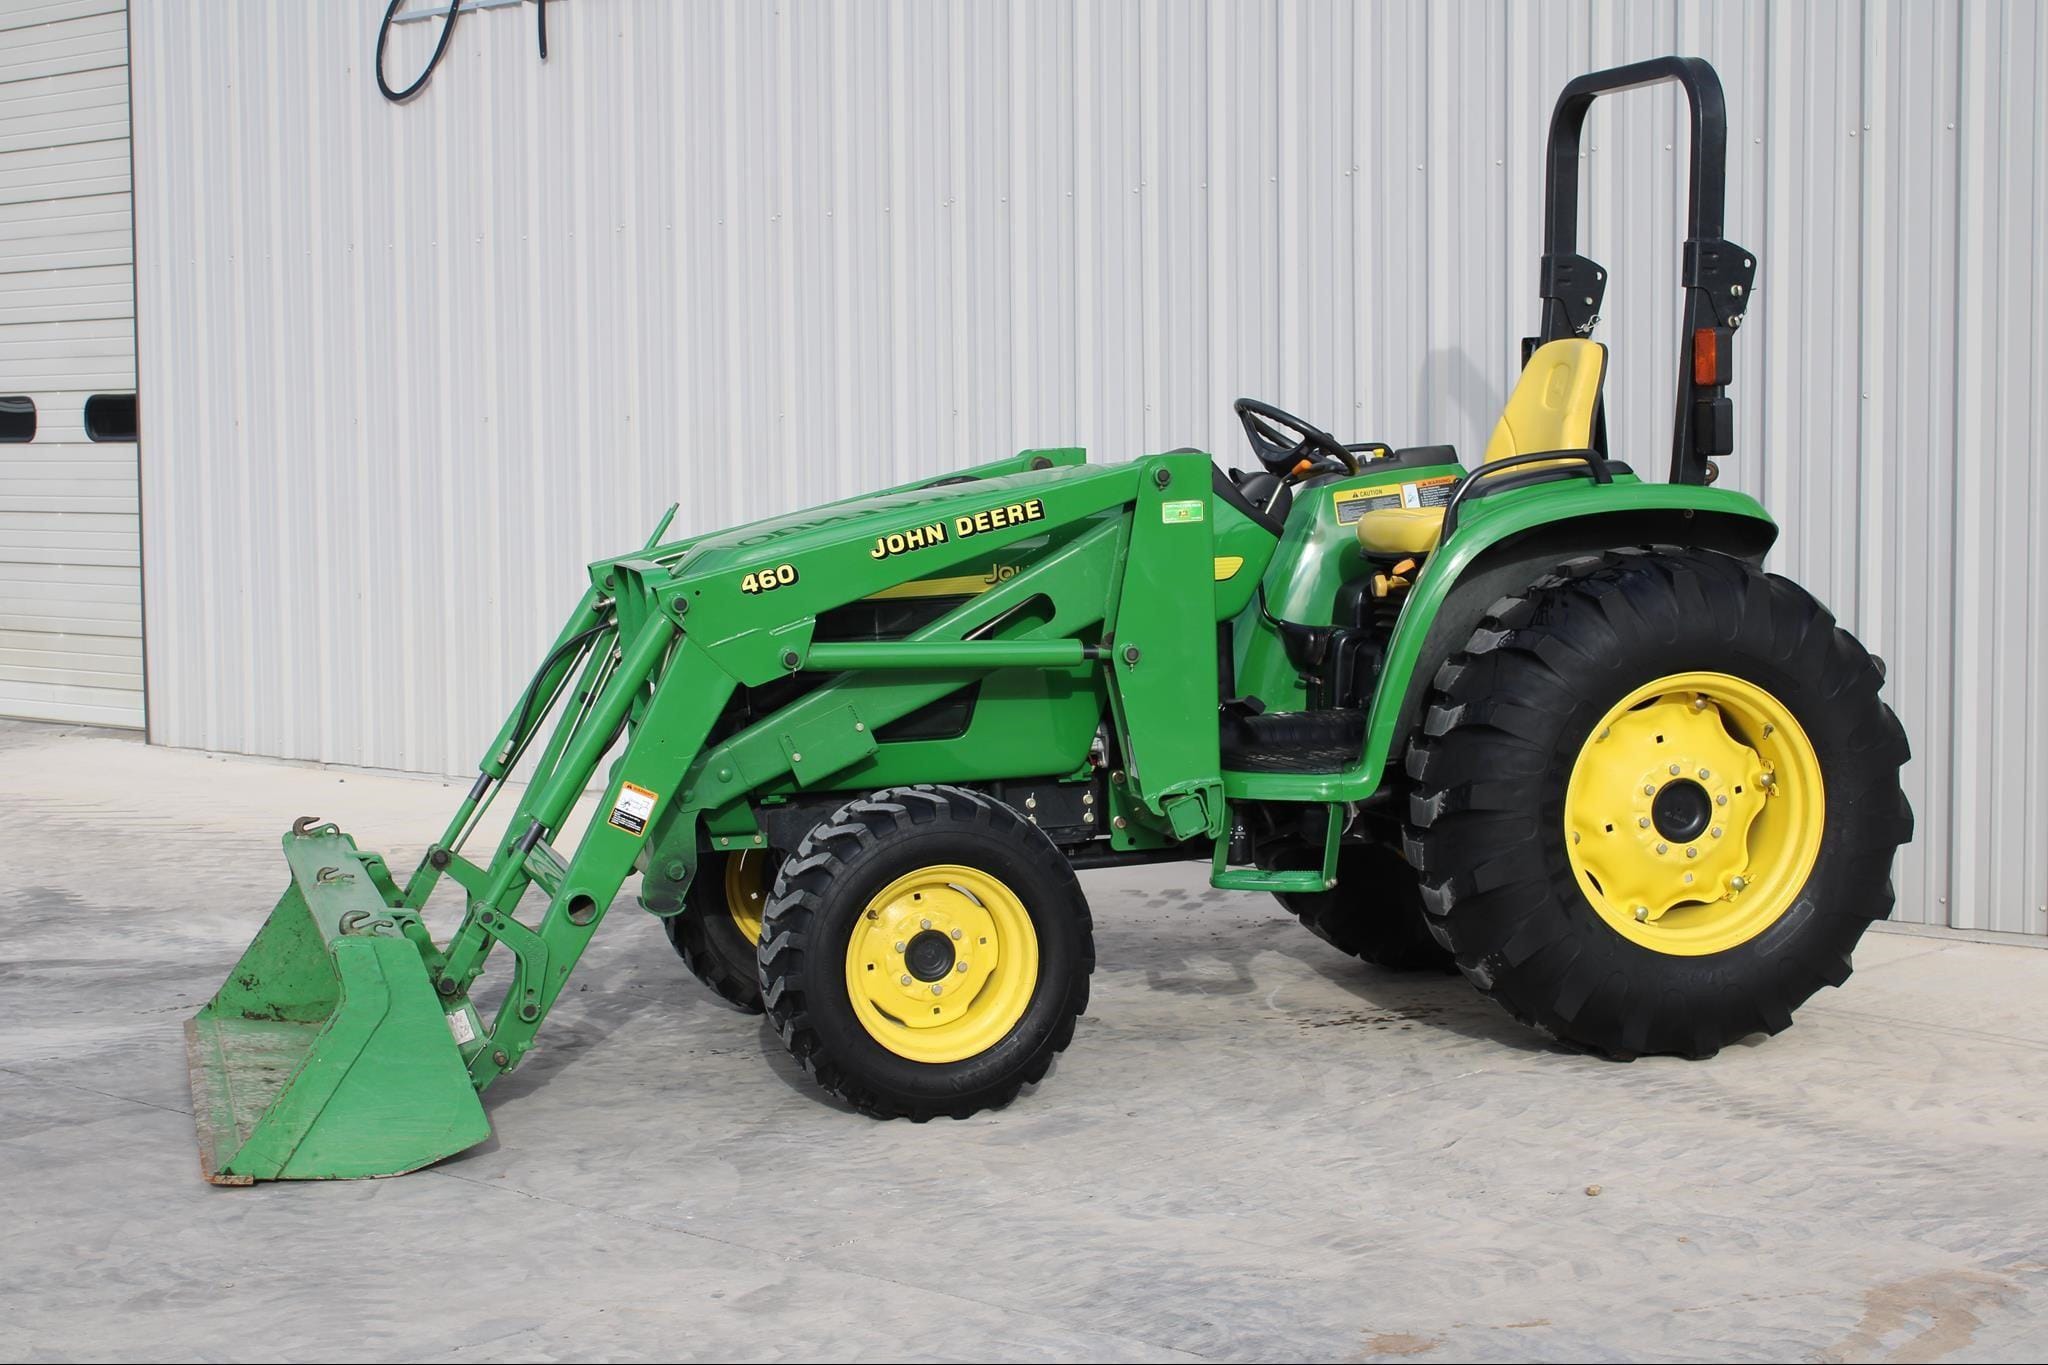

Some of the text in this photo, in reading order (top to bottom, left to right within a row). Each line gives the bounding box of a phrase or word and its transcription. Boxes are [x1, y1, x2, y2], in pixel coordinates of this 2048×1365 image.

[1359, 489, 1383, 497] CAUTION
[870, 498, 1045, 560] JOHN DEERE
[741, 563, 799, 595] 460
